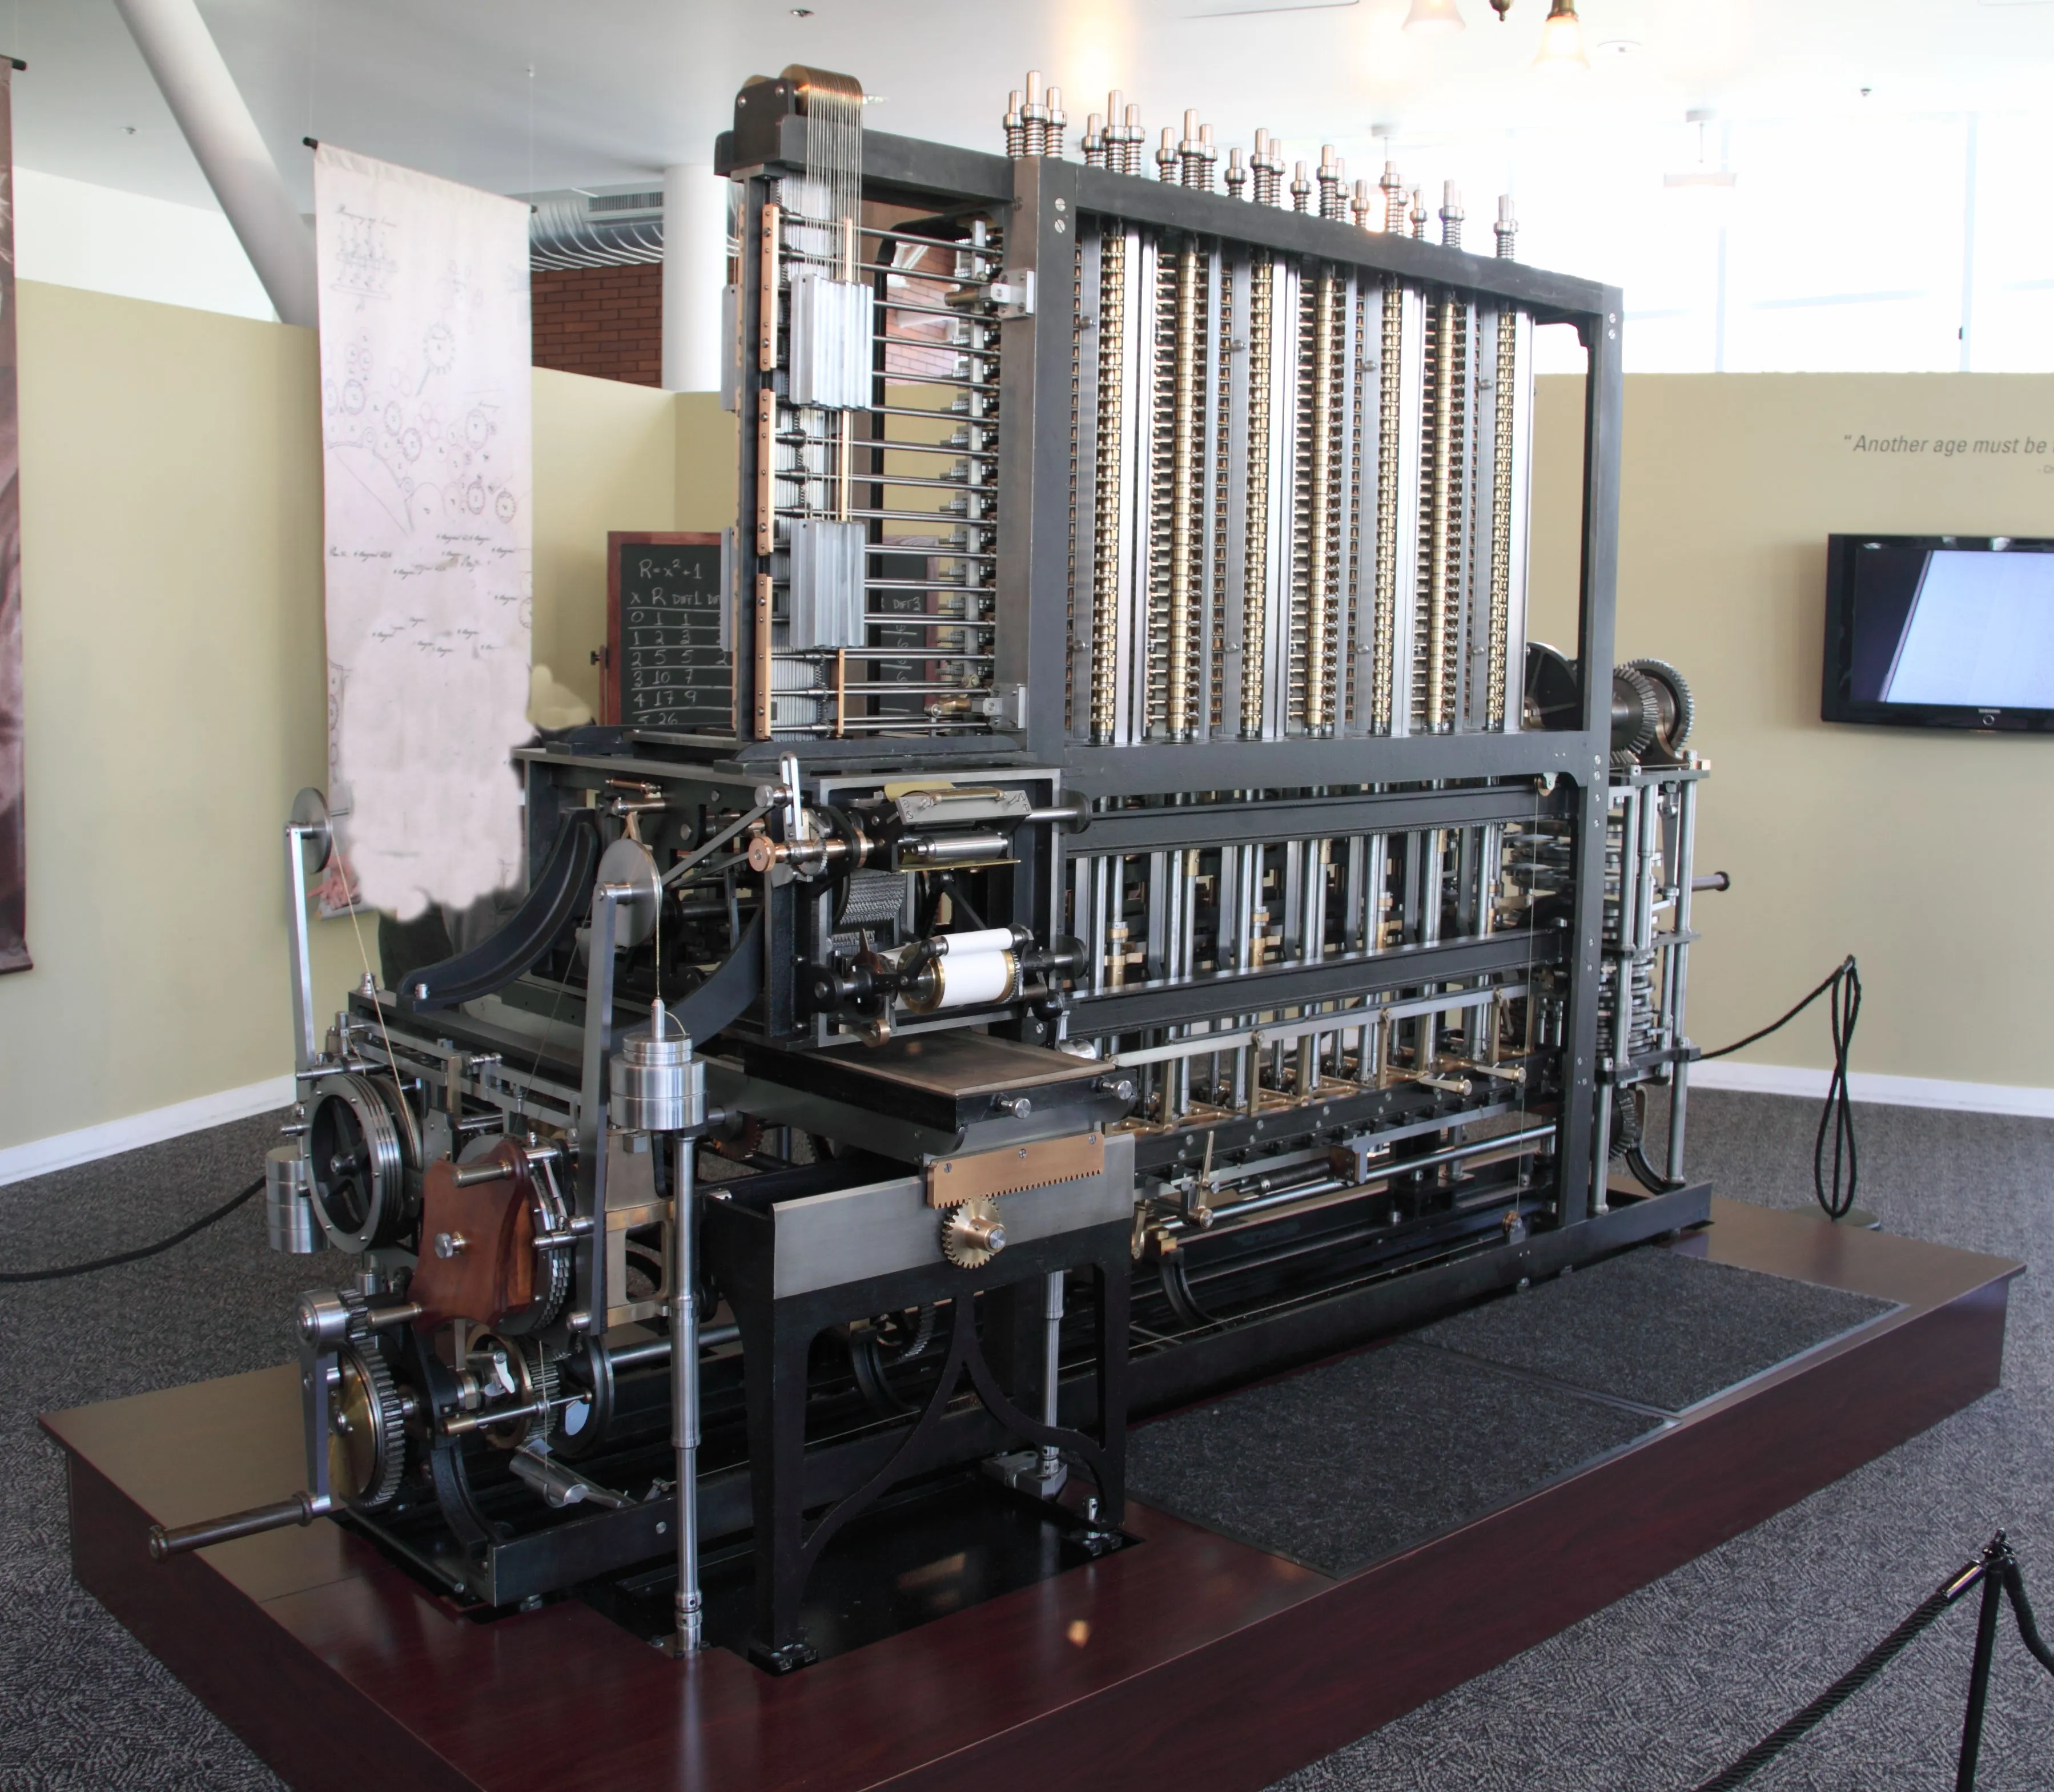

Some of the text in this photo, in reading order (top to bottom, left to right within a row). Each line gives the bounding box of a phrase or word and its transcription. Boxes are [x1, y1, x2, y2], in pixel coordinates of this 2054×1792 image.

[1933, 439, 1968, 457] age
[1973, 438, 2019, 454] must
[2024, 437, 2048, 454] be
[652, 587, 666, 605] R
[631, 611, 690, 626] 0 1 1
[633, 629, 690, 646] 1 2 3
[631, 649, 727, 667] 2 5 5 2
[633, 669, 693, 688] 3 10 7
[633, 690, 697, 708] 4 17 9
[658, 712, 678, 725] 26
